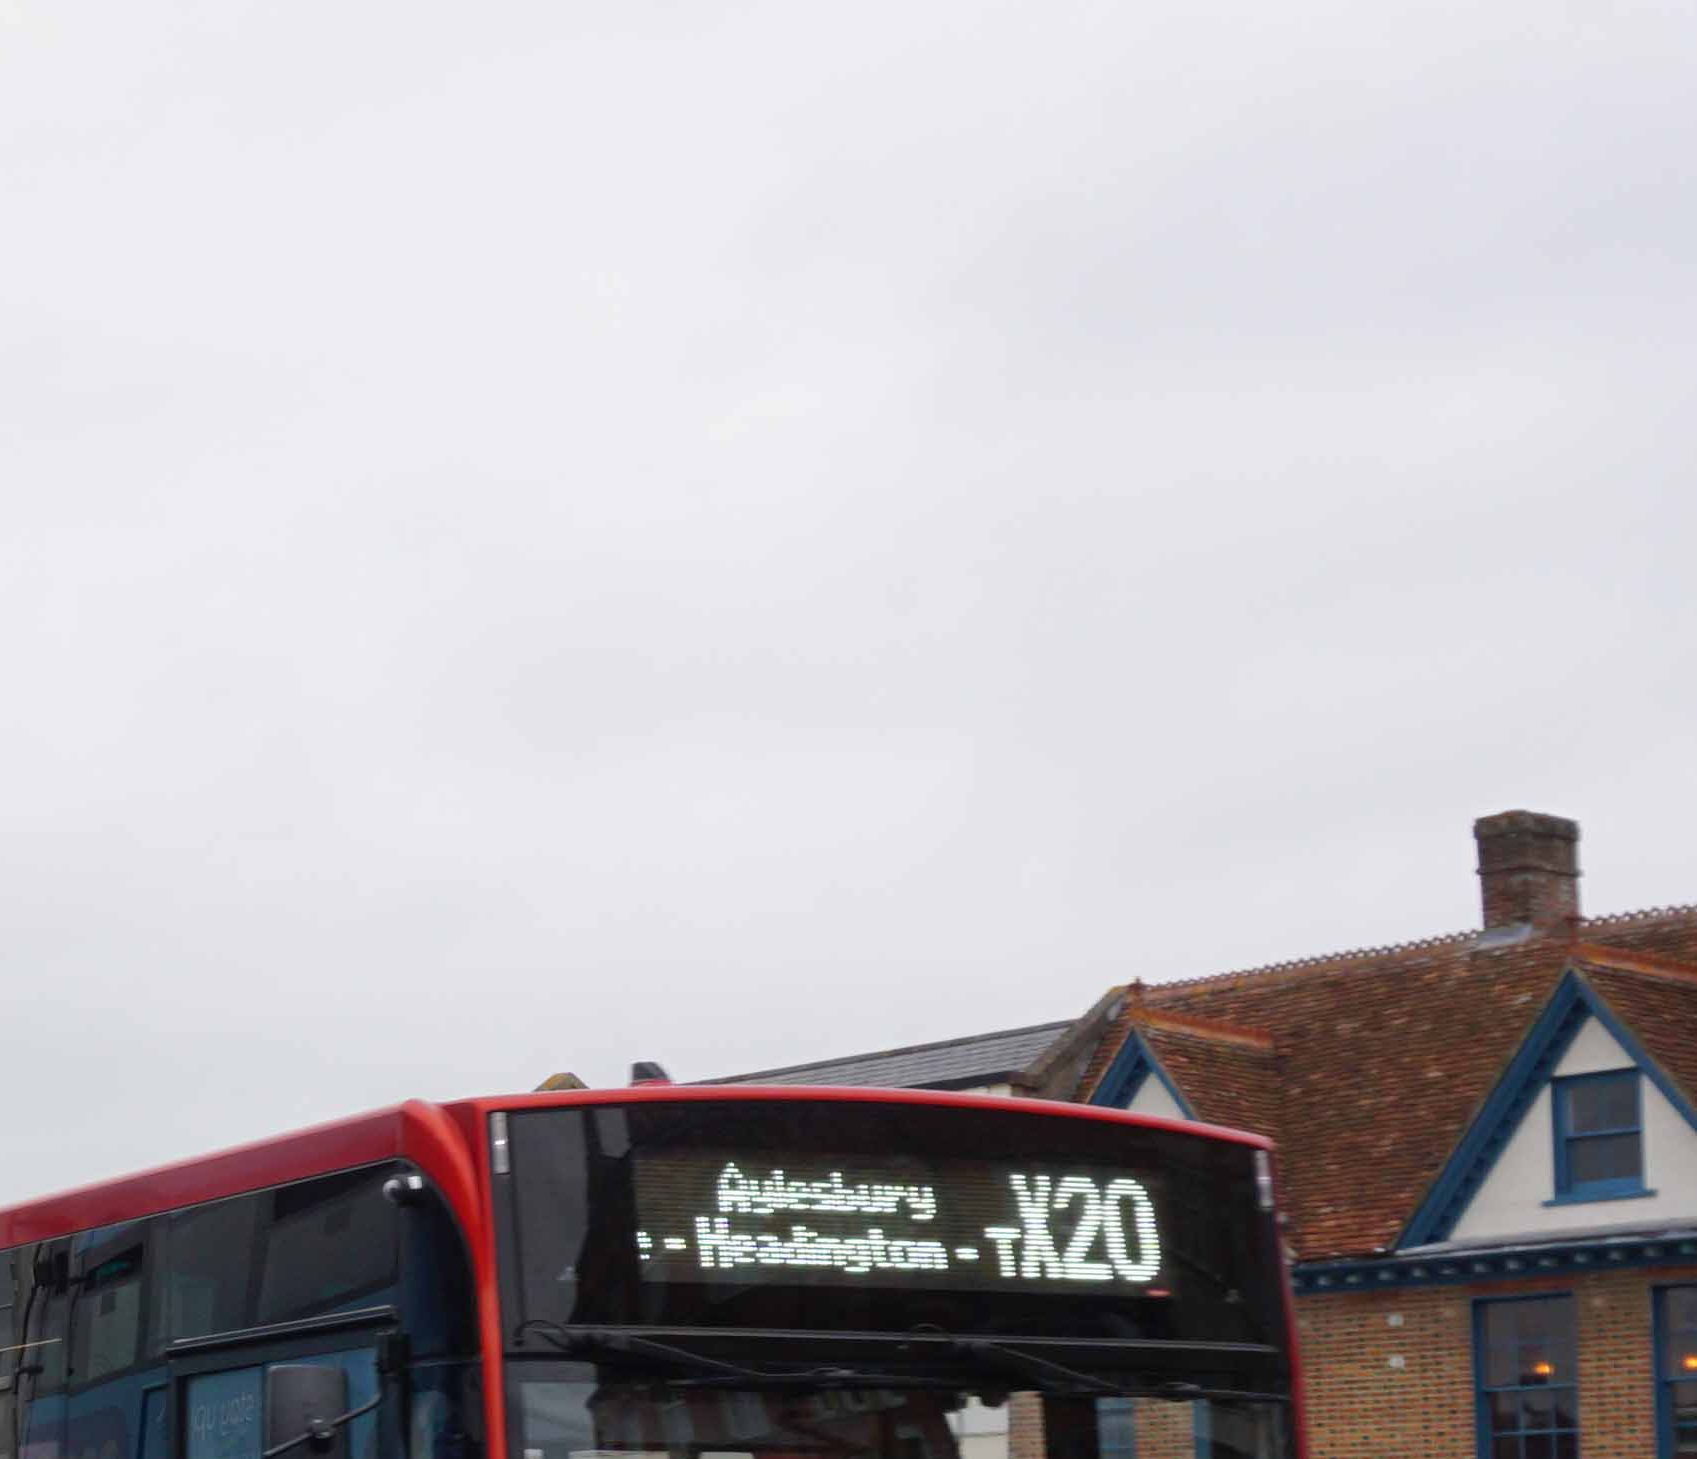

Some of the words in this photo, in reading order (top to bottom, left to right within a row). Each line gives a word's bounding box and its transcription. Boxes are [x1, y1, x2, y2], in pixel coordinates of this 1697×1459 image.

[717, 1162, 937, 1219] Aylesbury
[695, 1216, 949, 1273] Headington
[1008, 1174, 1162, 1282] X20
